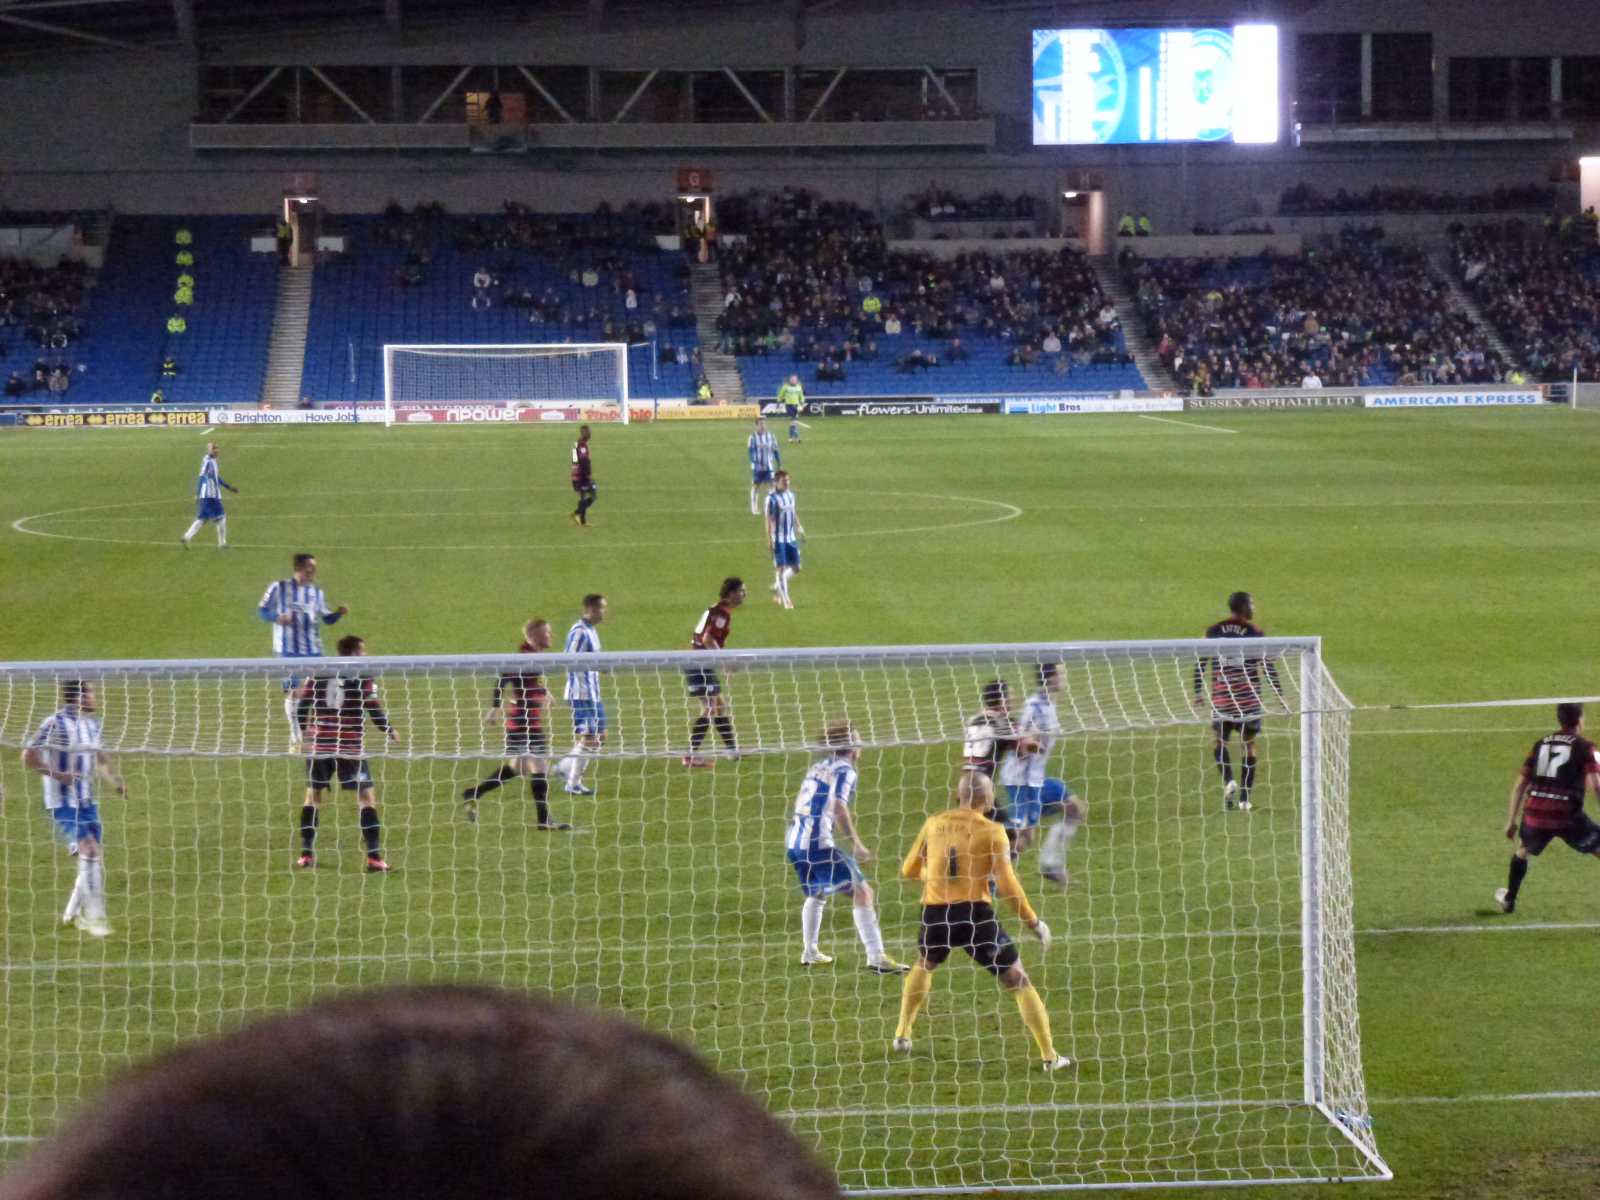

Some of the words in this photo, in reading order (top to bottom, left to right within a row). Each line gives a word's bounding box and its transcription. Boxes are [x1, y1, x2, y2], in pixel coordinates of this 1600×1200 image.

[1190, 399, 1243, 408] SUSSEX
[1374, 396, 1458, 406] AMERICAN
[1464, 394, 1536, 404] EXPRESS
[1059, 402, 1081, 411] Bros
[234, 412, 282, 424] Brighton
[305, 412, 333, 422] Hove
[335, 412, 360, 422] Jobs
[446, 408, 526, 421] npower
[1536, 744, 1572, 778] 17
